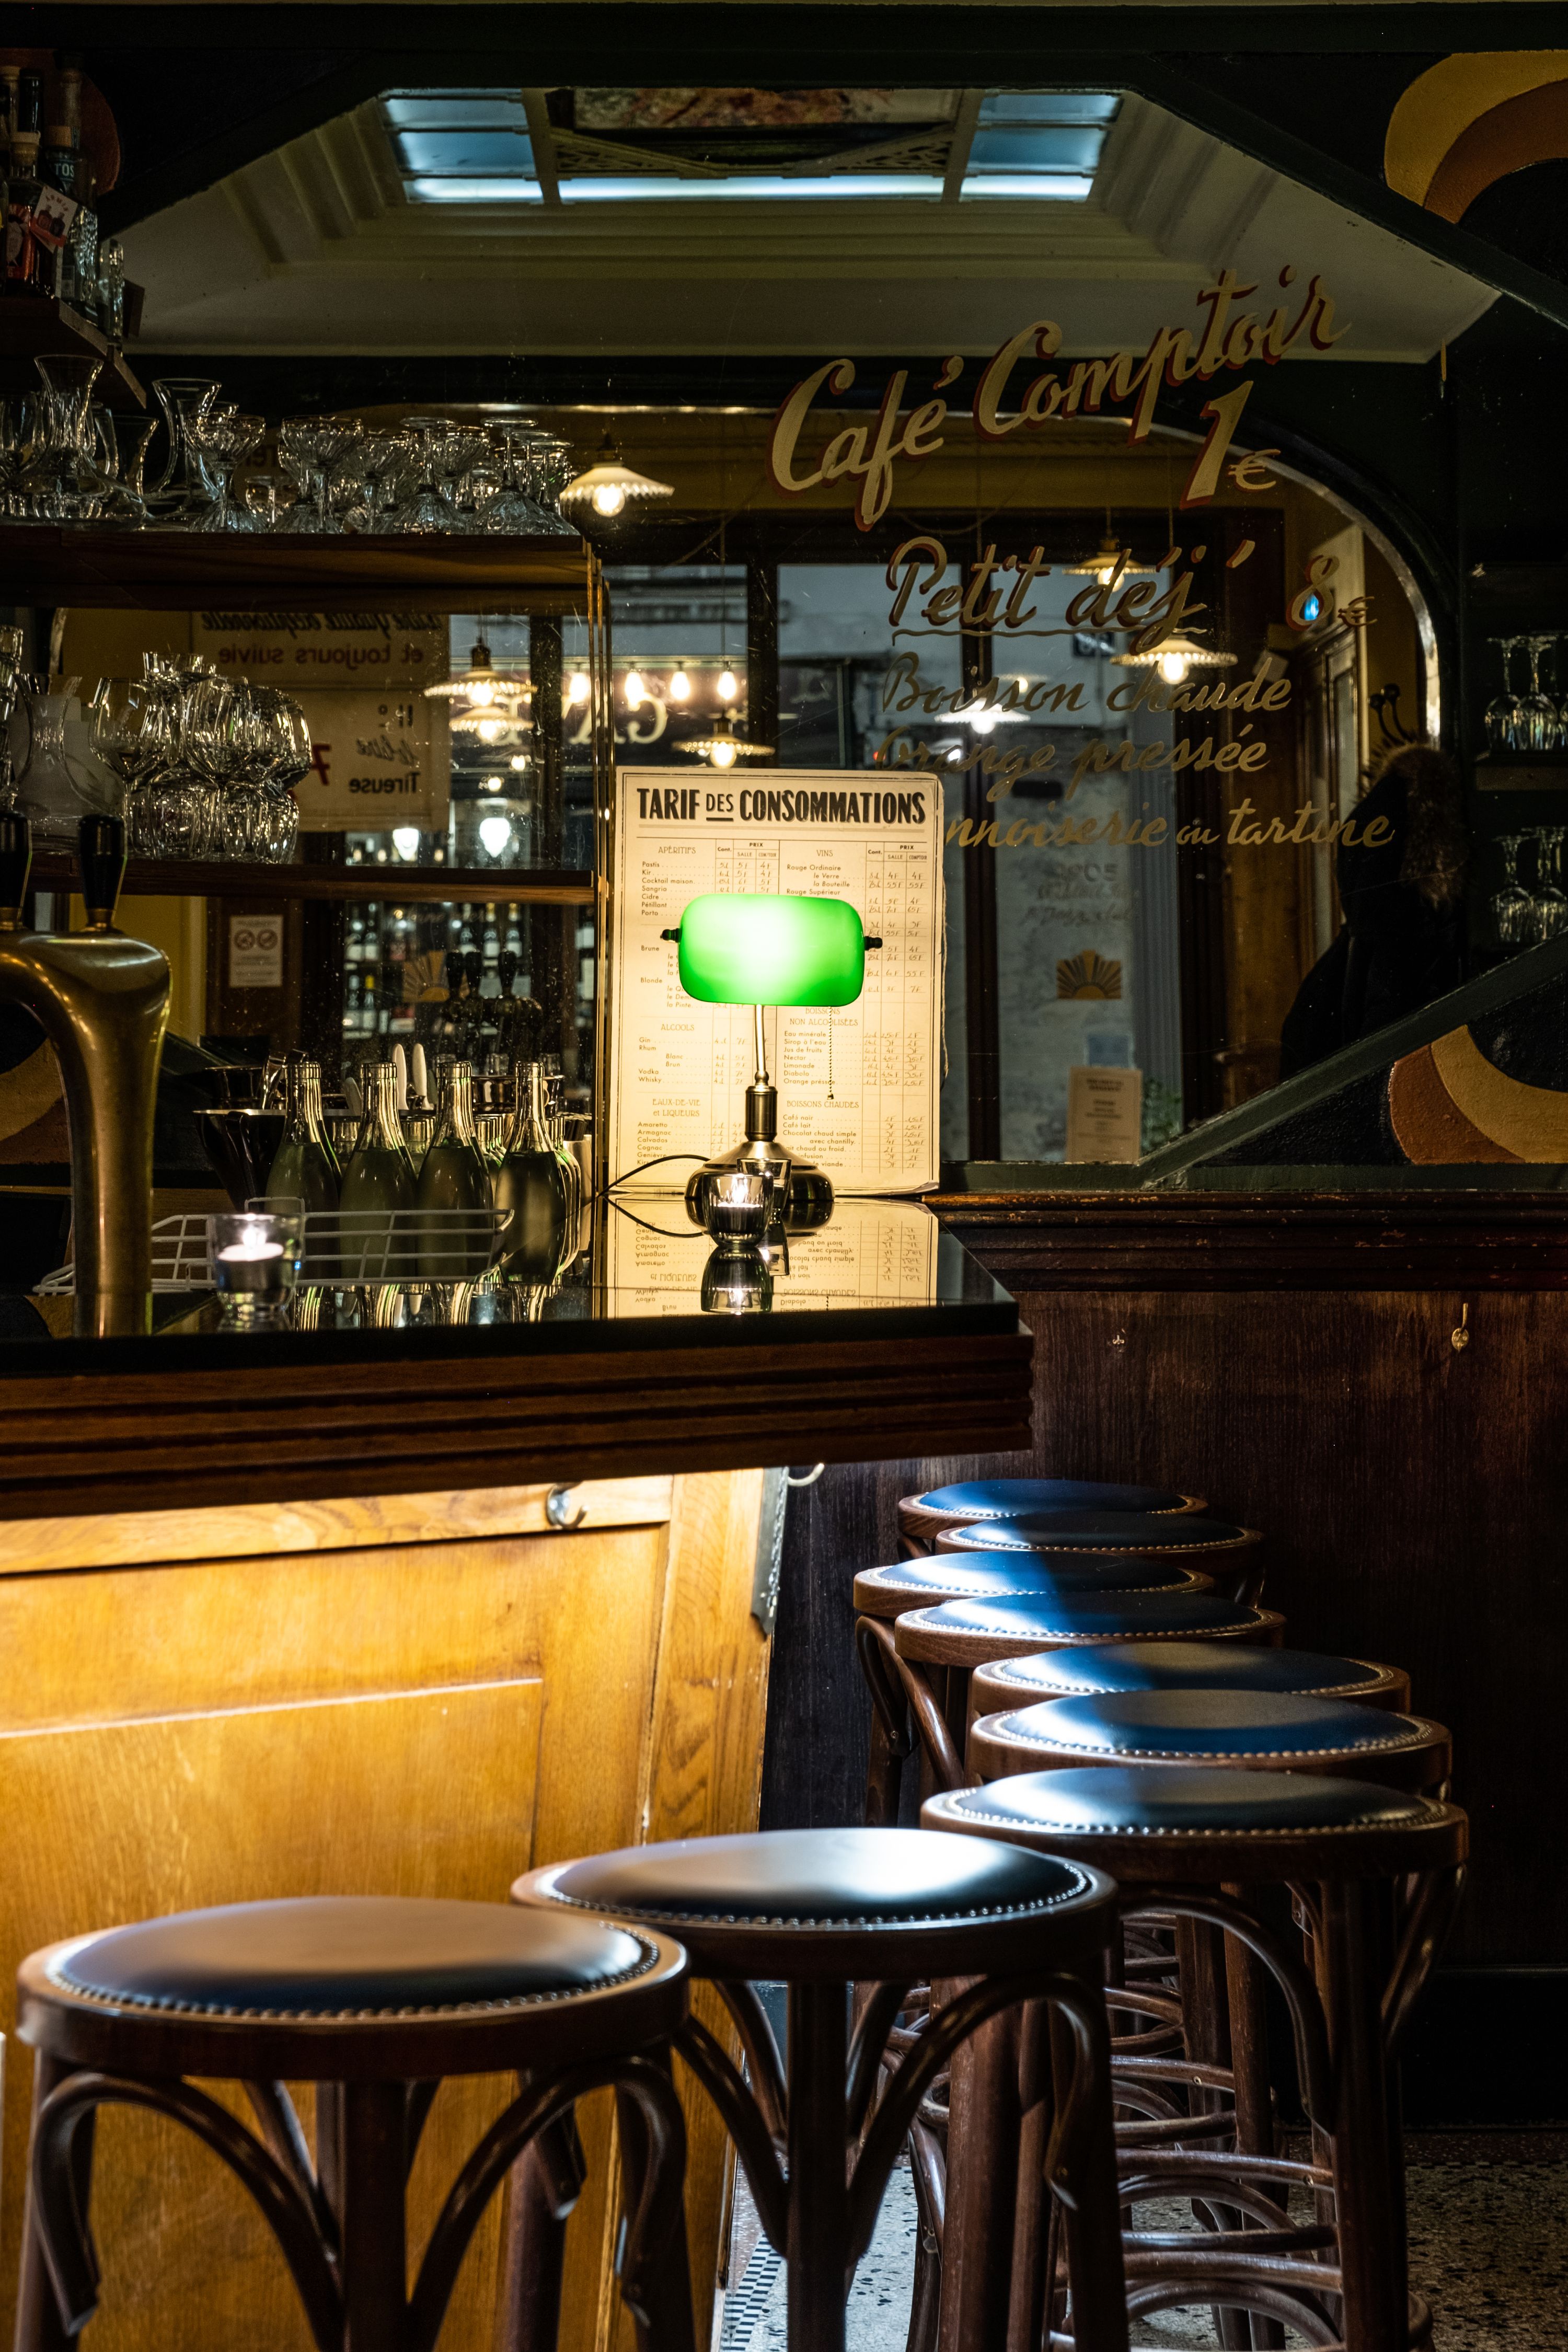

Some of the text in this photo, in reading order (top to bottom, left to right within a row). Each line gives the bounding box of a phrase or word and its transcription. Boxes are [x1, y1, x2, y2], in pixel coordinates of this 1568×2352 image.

[766, 264, 1352, 532] Café Comptoir
[884, 536, 1051, 629] Petit
[882, 652, 1292, 713] Boisson chaude
[875, 723, 1271, 803] Orange pressée
[637, 788, 926, 824] TARIF DES CONSOMMATIONS
[945, 798, 1396, 848] nnoiserie ou tartine
[658, 845, 696, 854] APÉRITIFS
[808, 1017, 859, 1026] ALCOOLISÉES
